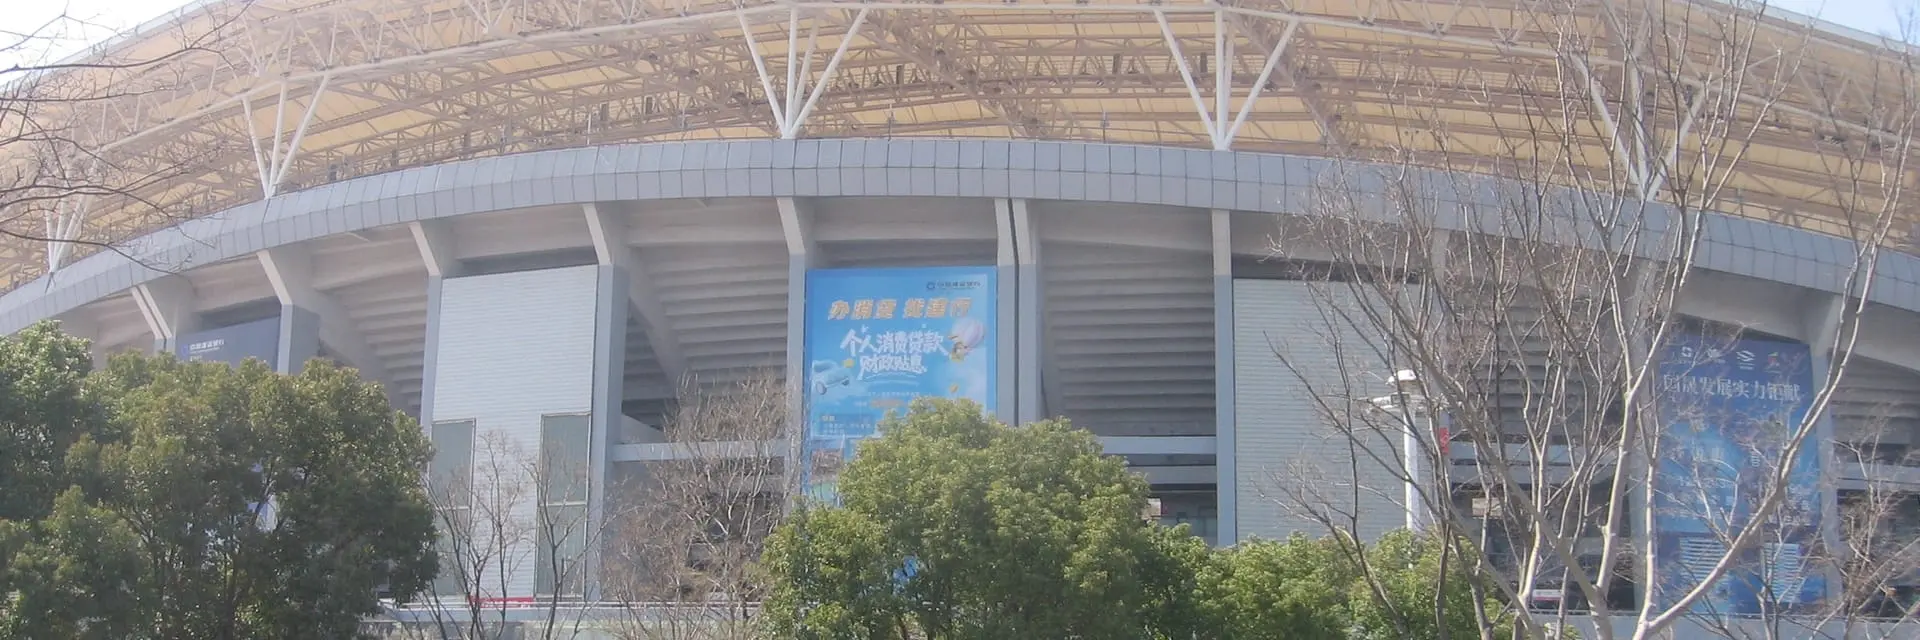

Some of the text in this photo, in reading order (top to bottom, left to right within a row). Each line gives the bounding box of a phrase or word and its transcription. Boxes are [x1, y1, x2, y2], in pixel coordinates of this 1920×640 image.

[840, 328, 950, 357] 个人消费贷款
[856, 354, 928, 381] 财政贴息
